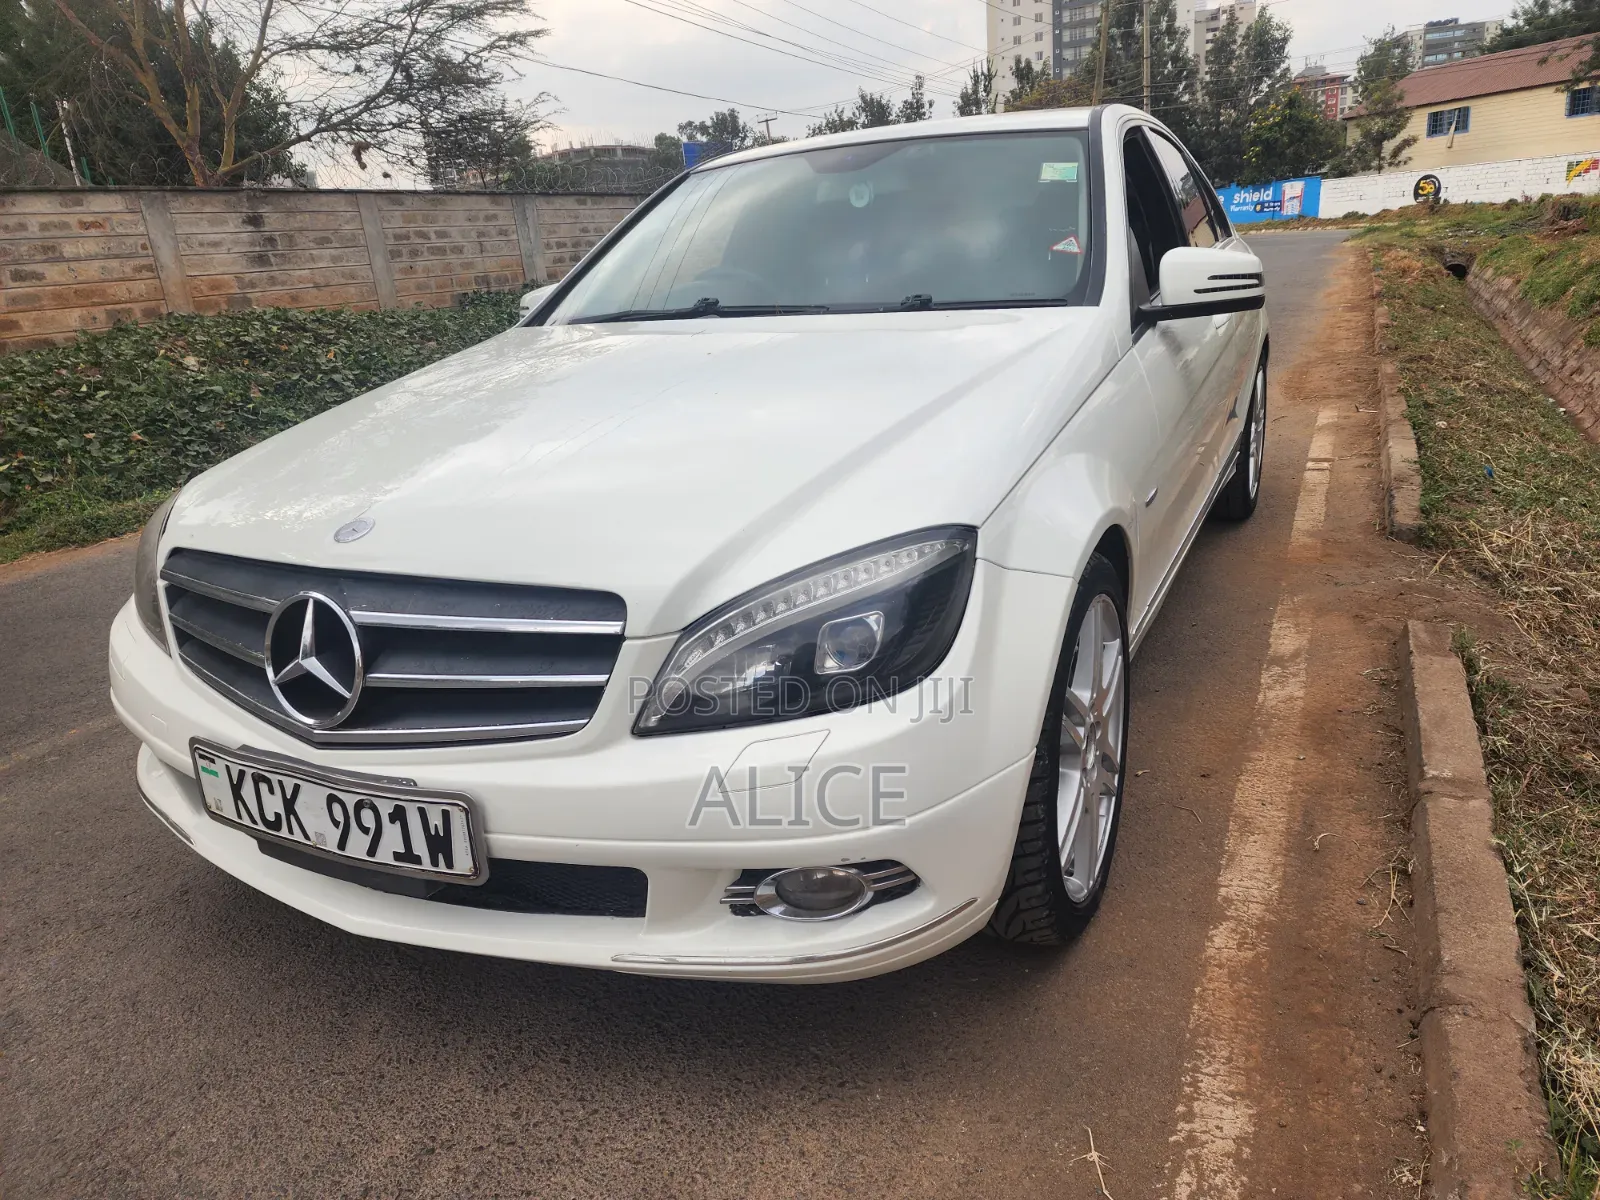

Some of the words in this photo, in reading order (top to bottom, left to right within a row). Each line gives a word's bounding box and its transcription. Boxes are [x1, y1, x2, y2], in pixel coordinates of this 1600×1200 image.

[1233, 187, 1273, 203] shield
[225, 763, 311, 841] KCK
[325, 793, 455, 870] 991W
